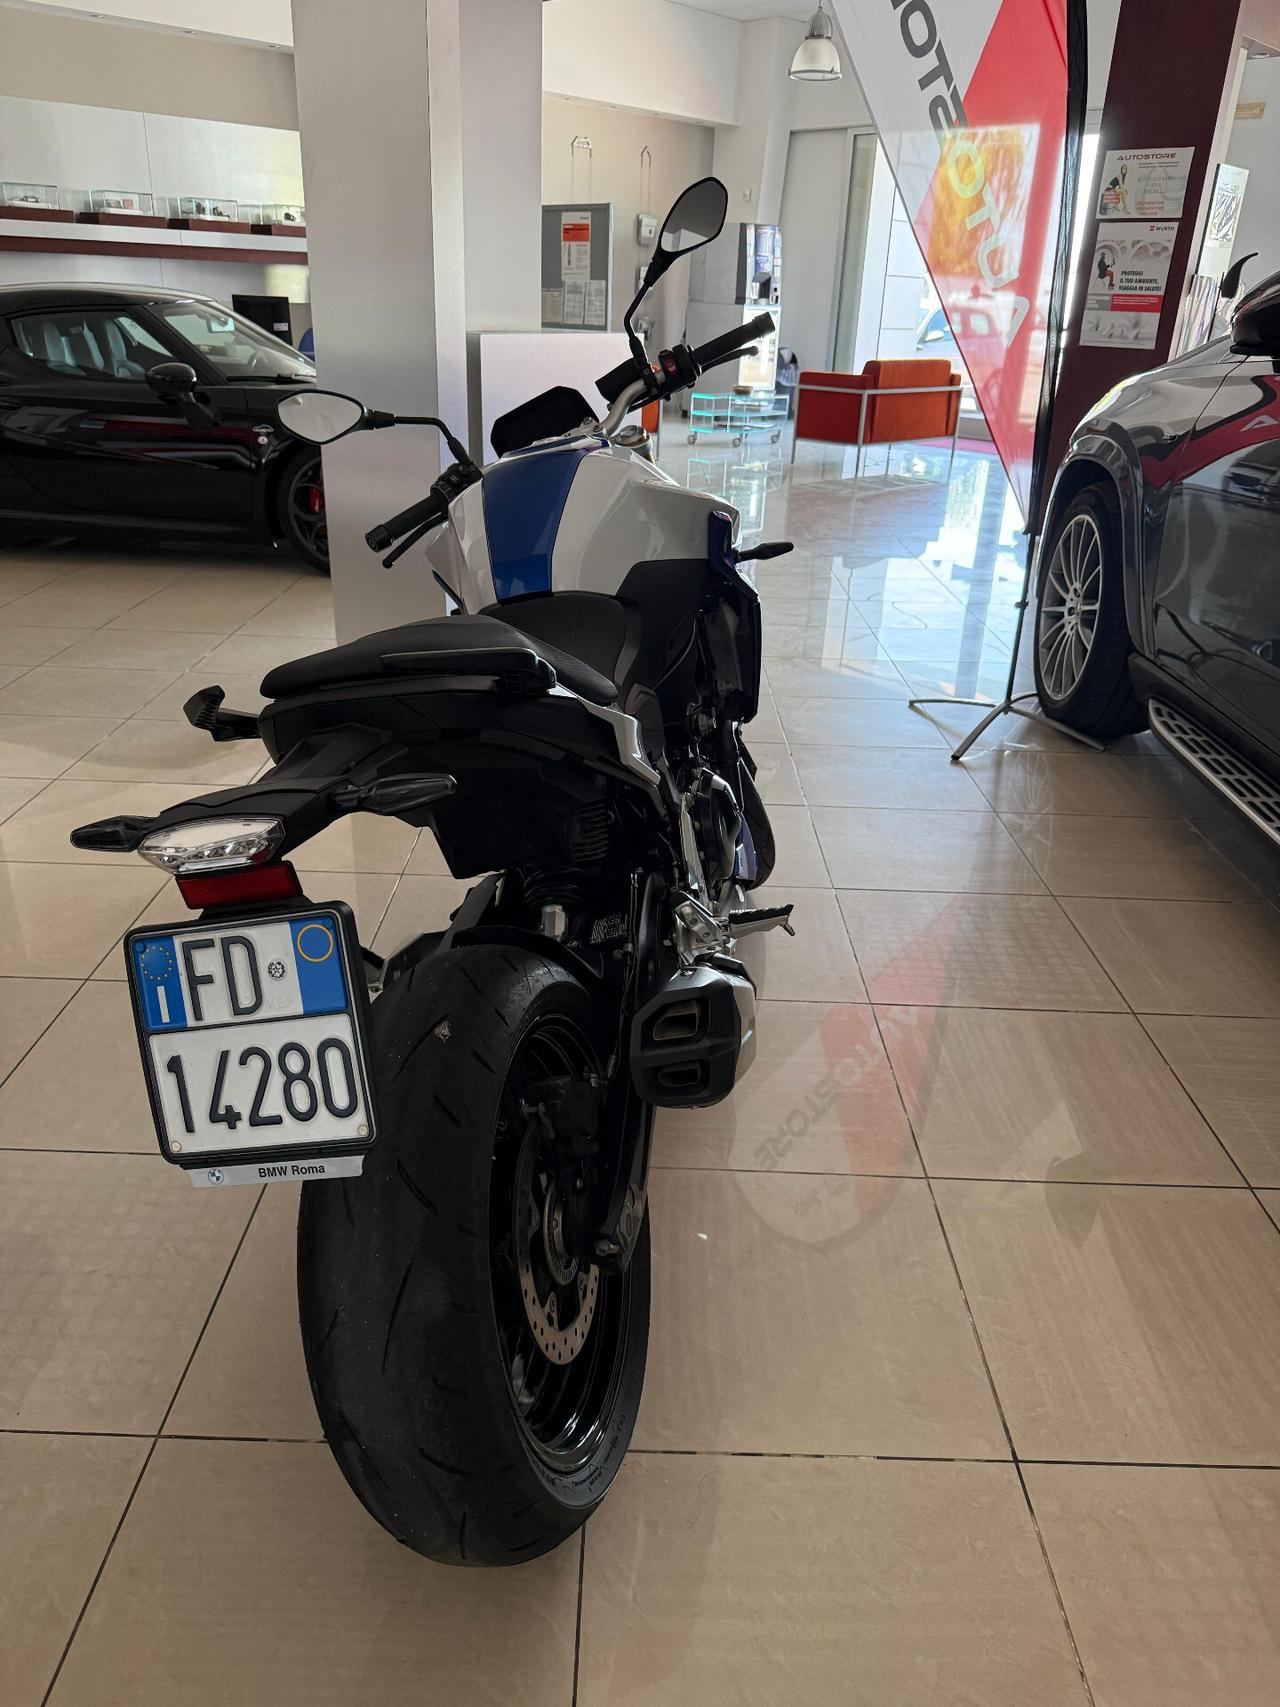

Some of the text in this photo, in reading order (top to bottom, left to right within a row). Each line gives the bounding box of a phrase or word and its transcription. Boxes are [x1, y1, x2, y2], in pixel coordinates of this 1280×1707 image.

[1117, 152, 1177, 161] AUTOSTORE
[182, 935, 263, 1021] FD
[167, 1038, 358, 1133] 14280
[258, 1164, 326, 1178] BMW Roma
